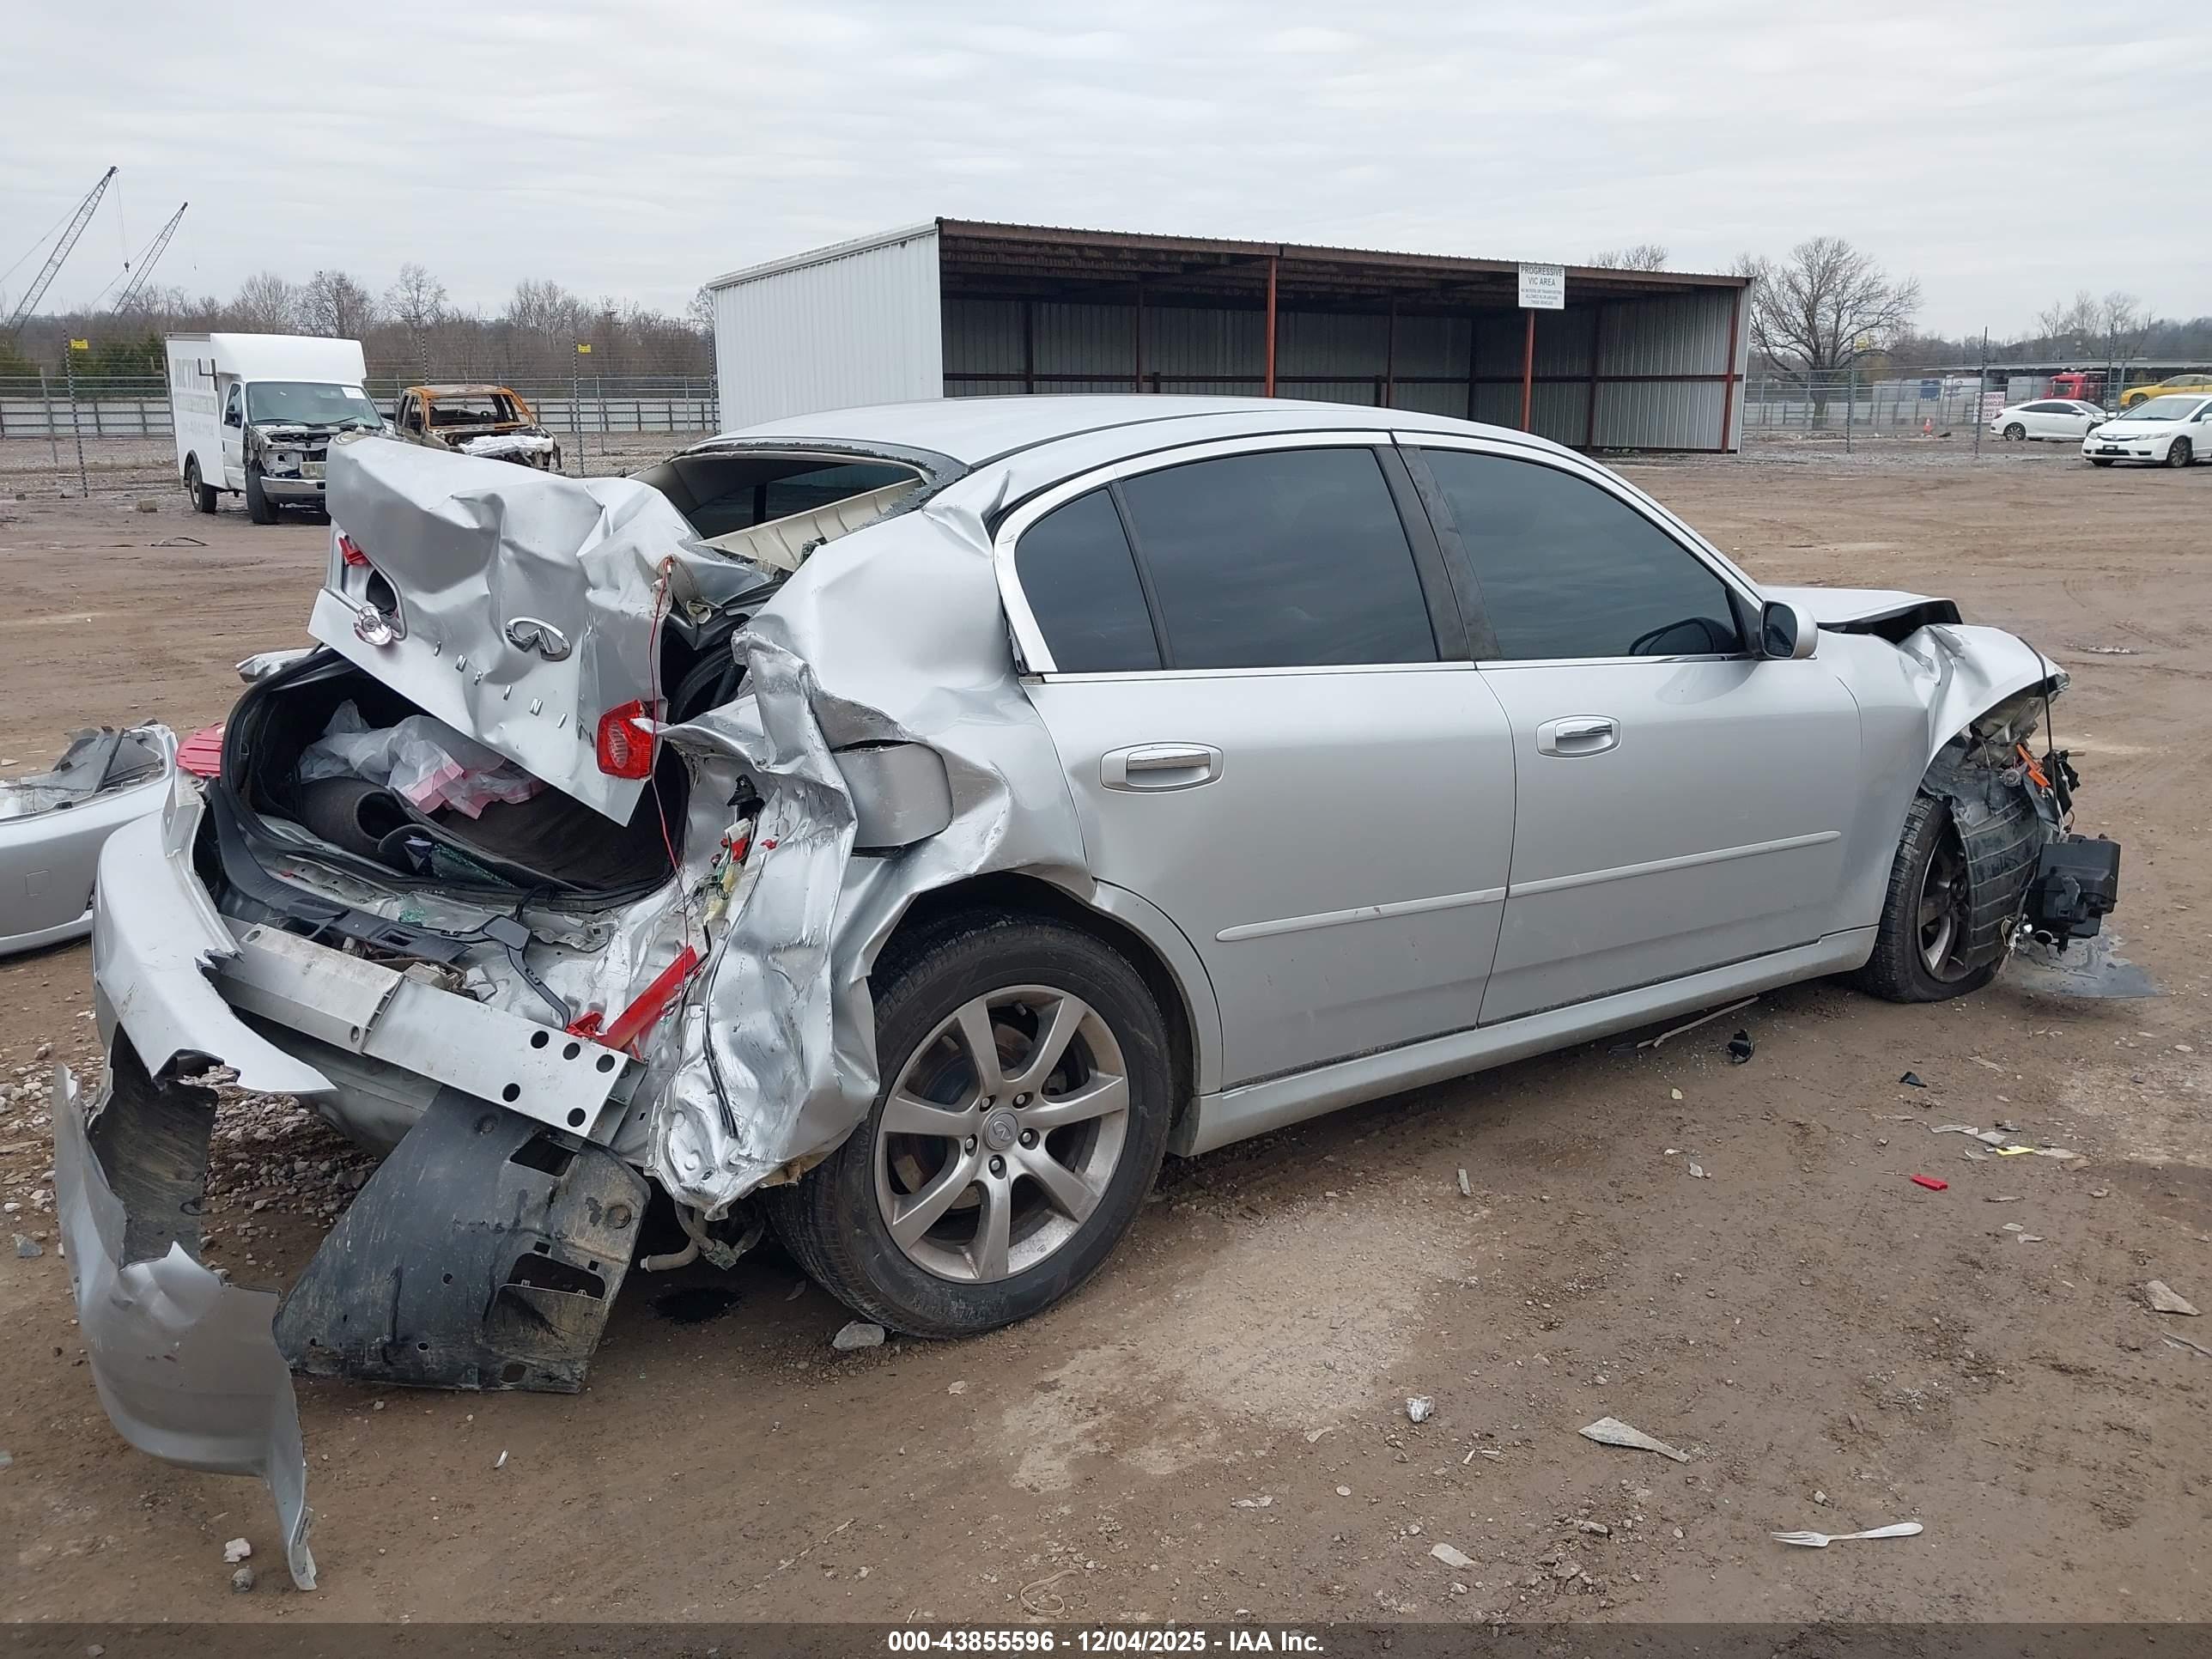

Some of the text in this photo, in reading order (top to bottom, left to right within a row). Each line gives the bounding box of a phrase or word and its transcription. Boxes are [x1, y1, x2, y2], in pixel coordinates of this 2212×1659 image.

[1521, 265, 1563, 276] PROGRESSIVE
[1528, 276, 1556, 287] VIC AREA
